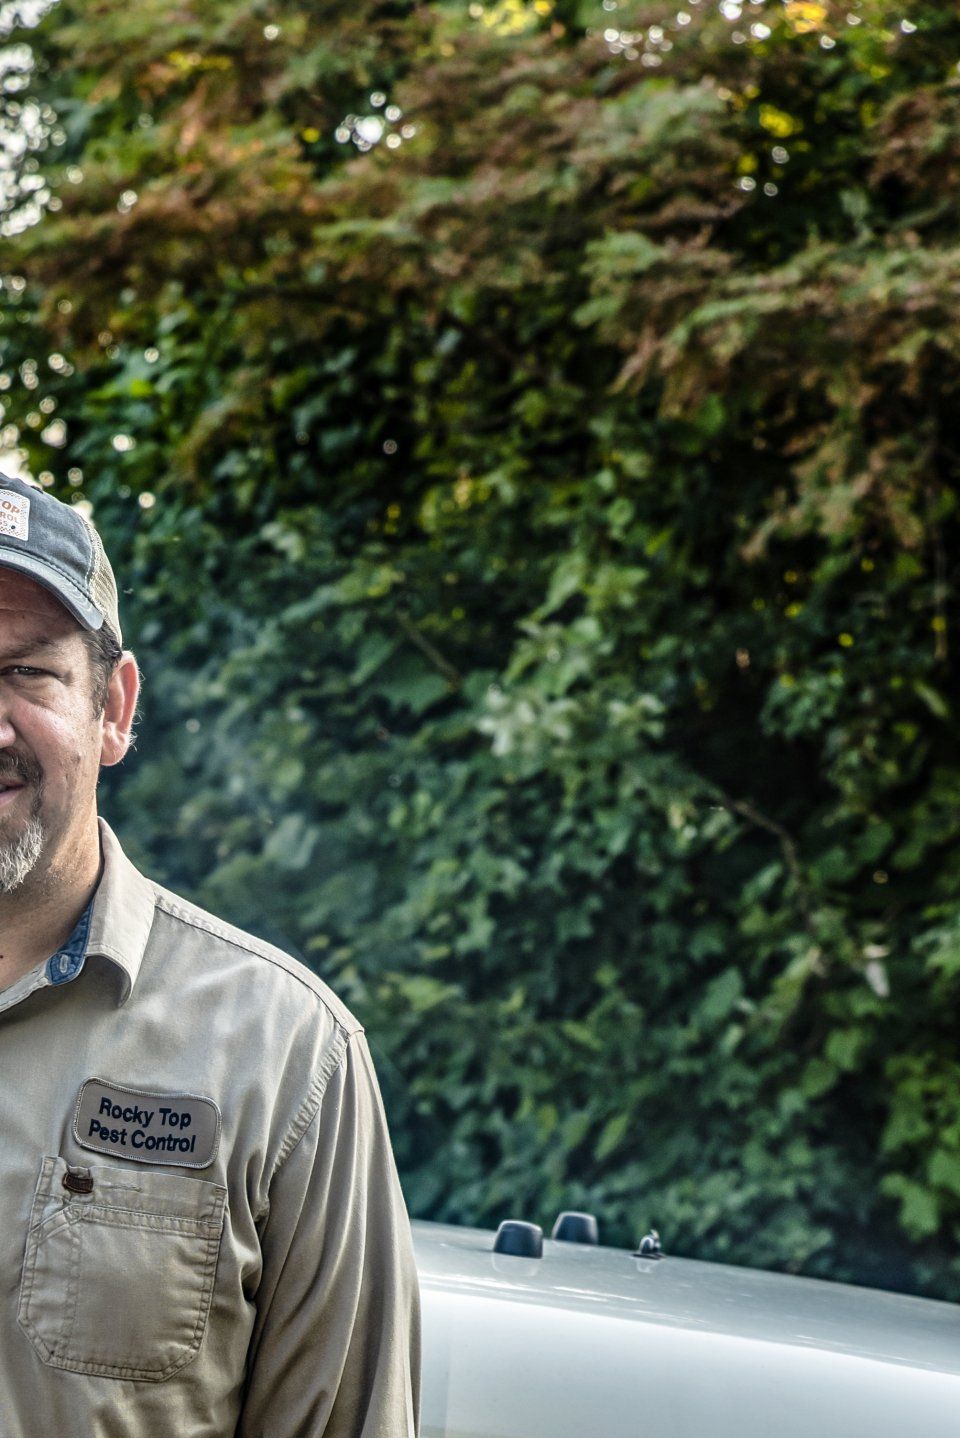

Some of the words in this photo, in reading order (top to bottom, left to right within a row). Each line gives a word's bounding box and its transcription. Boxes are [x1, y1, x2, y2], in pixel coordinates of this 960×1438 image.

[99, 1097, 154, 1128] Rocky
[159, 1108, 192, 1130] Top
[88, 1119, 128, 1145] Pest
[131, 1129, 196, 1152] Control
